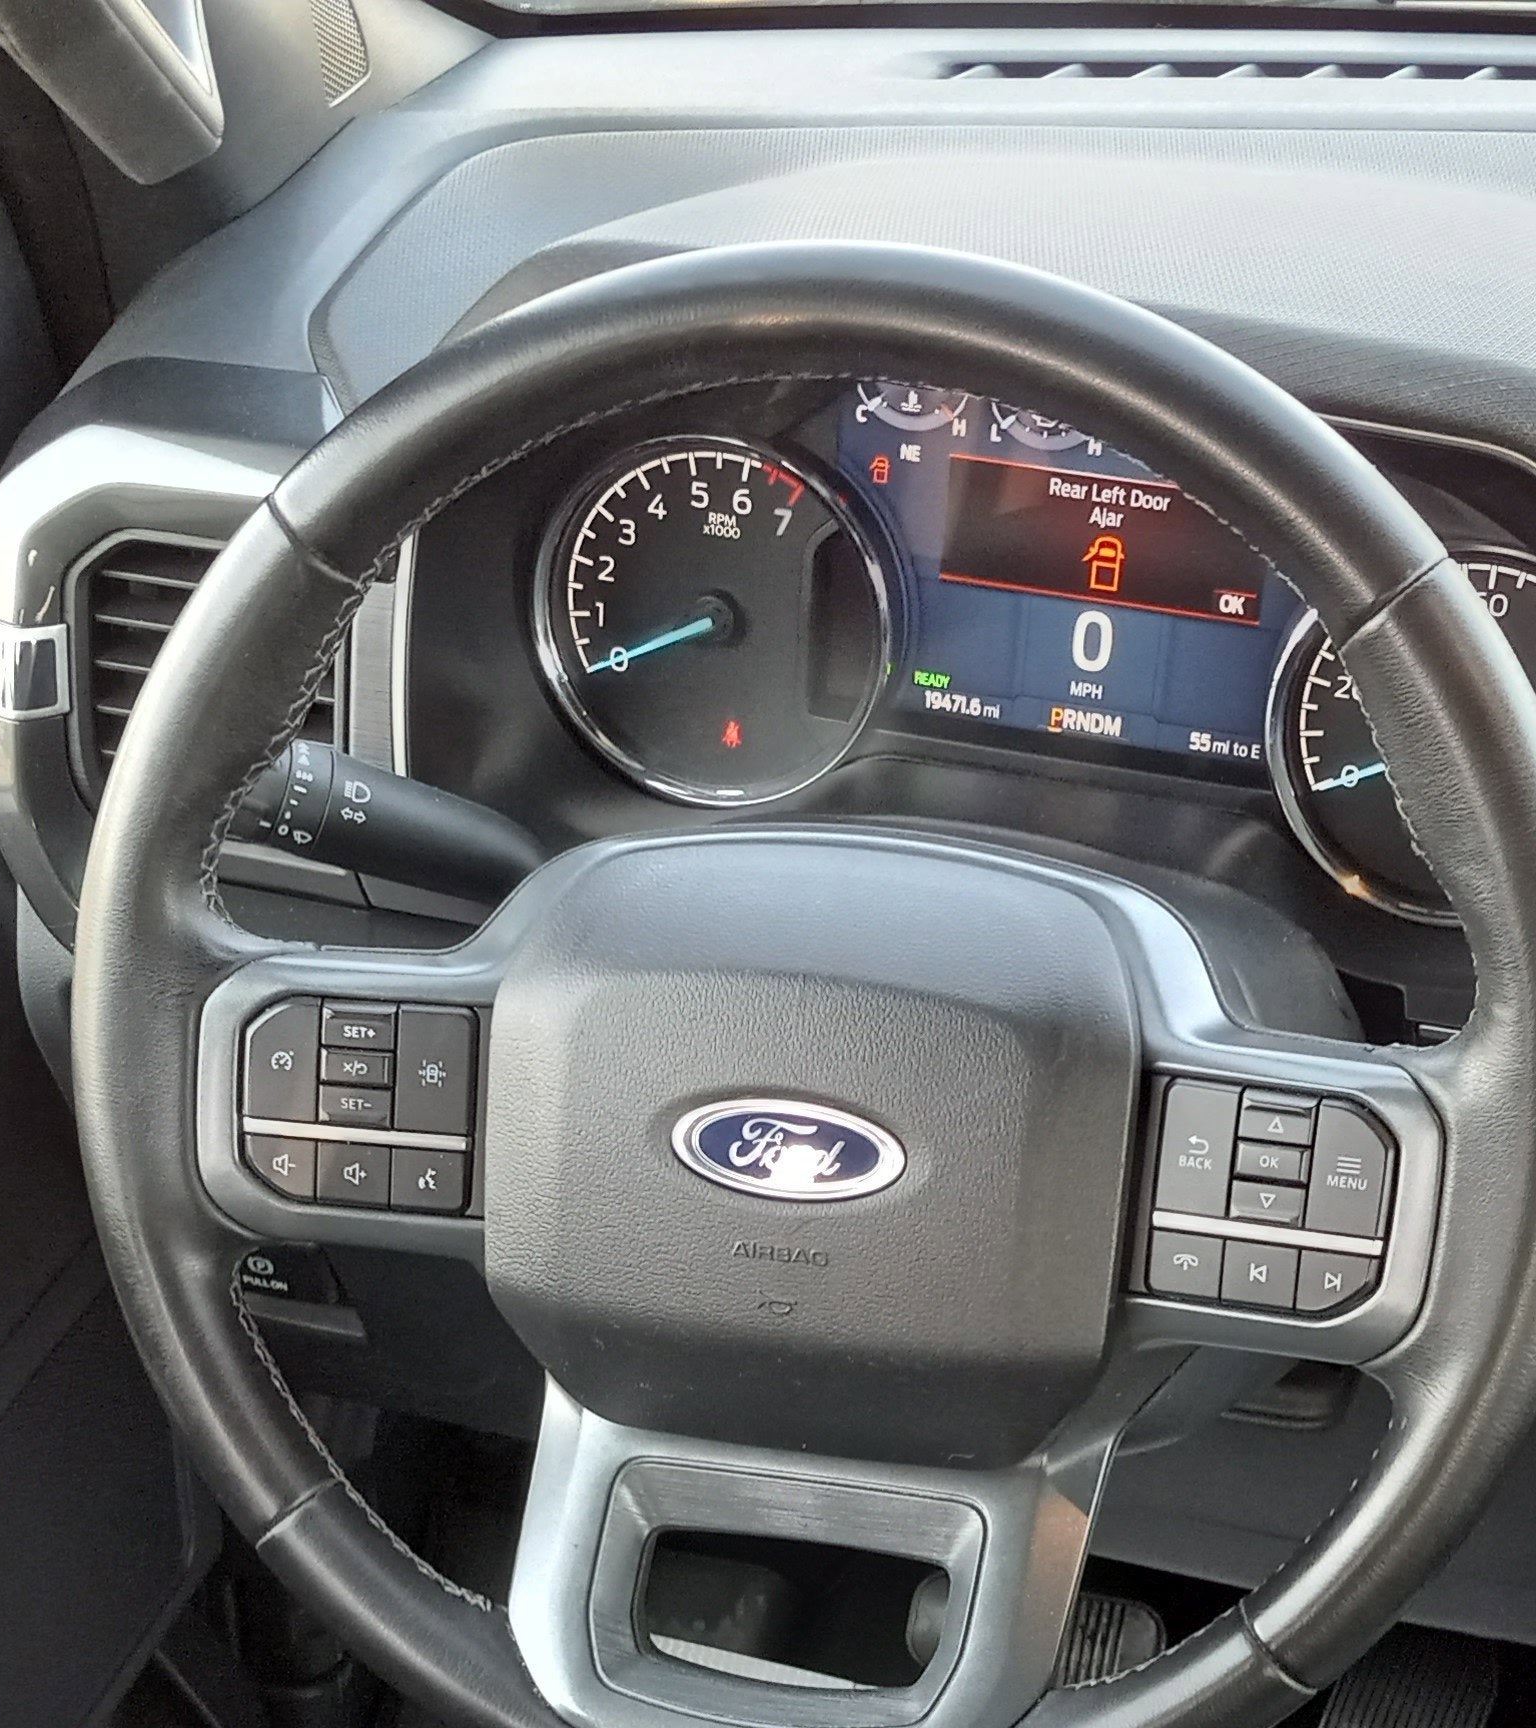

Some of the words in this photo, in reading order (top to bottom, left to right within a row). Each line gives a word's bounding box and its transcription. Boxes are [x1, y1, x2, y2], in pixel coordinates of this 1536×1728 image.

[855, 404, 868, 423] C
[951, 418, 967, 438] H
[990, 423, 1002, 442] L
[900, 443, 921, 462] NE
[1087, 437, 1103, 456] H
[647, 493, 667, 520] 4
[690, 481, 709, 508] 5
[732, 489, 753, 515] 6
[1049, 477, 1087, 500] Rear
[1092, 483, 1127, 506] Left
[1130, 489, 1171, 512] Door
[708, 511, 737, 526] RPM
[773, 508, 792, 536] 7
[1088, 507, 1124, 529] Ajar
[618, 519, 636, 545] 3
[703, 523, 741, 539] x1000
[598, 556, 615, 582] 2
[595, 601, 605, 627] 1
[1219, 594, 1245, 616] OK
[1072, 610, 1113, 672] 0
[609, 646, 629, 672] 0
[914, 671, 951, 689] READY
[1070, 680, 1103, 700] MPH
[925, 690, 982, 716] 19471.6
[983, 704, 1000, 719] mi
[1050, 707, 1123, 738] PRNDM
[1189, 732, 1212, 753] 55
[1212, 740, 1230, 755] mi
[1233, 742, 1247, 757] to
[1251, 744, 1261, 760] E
[1178, 1154, 1212, 1170] BACK
[1259, 1155, 1280, 1169] OK
[1326, 1175, 1368, 1191] MENU
[732, 1240, 830, 1268] AIRBAG
